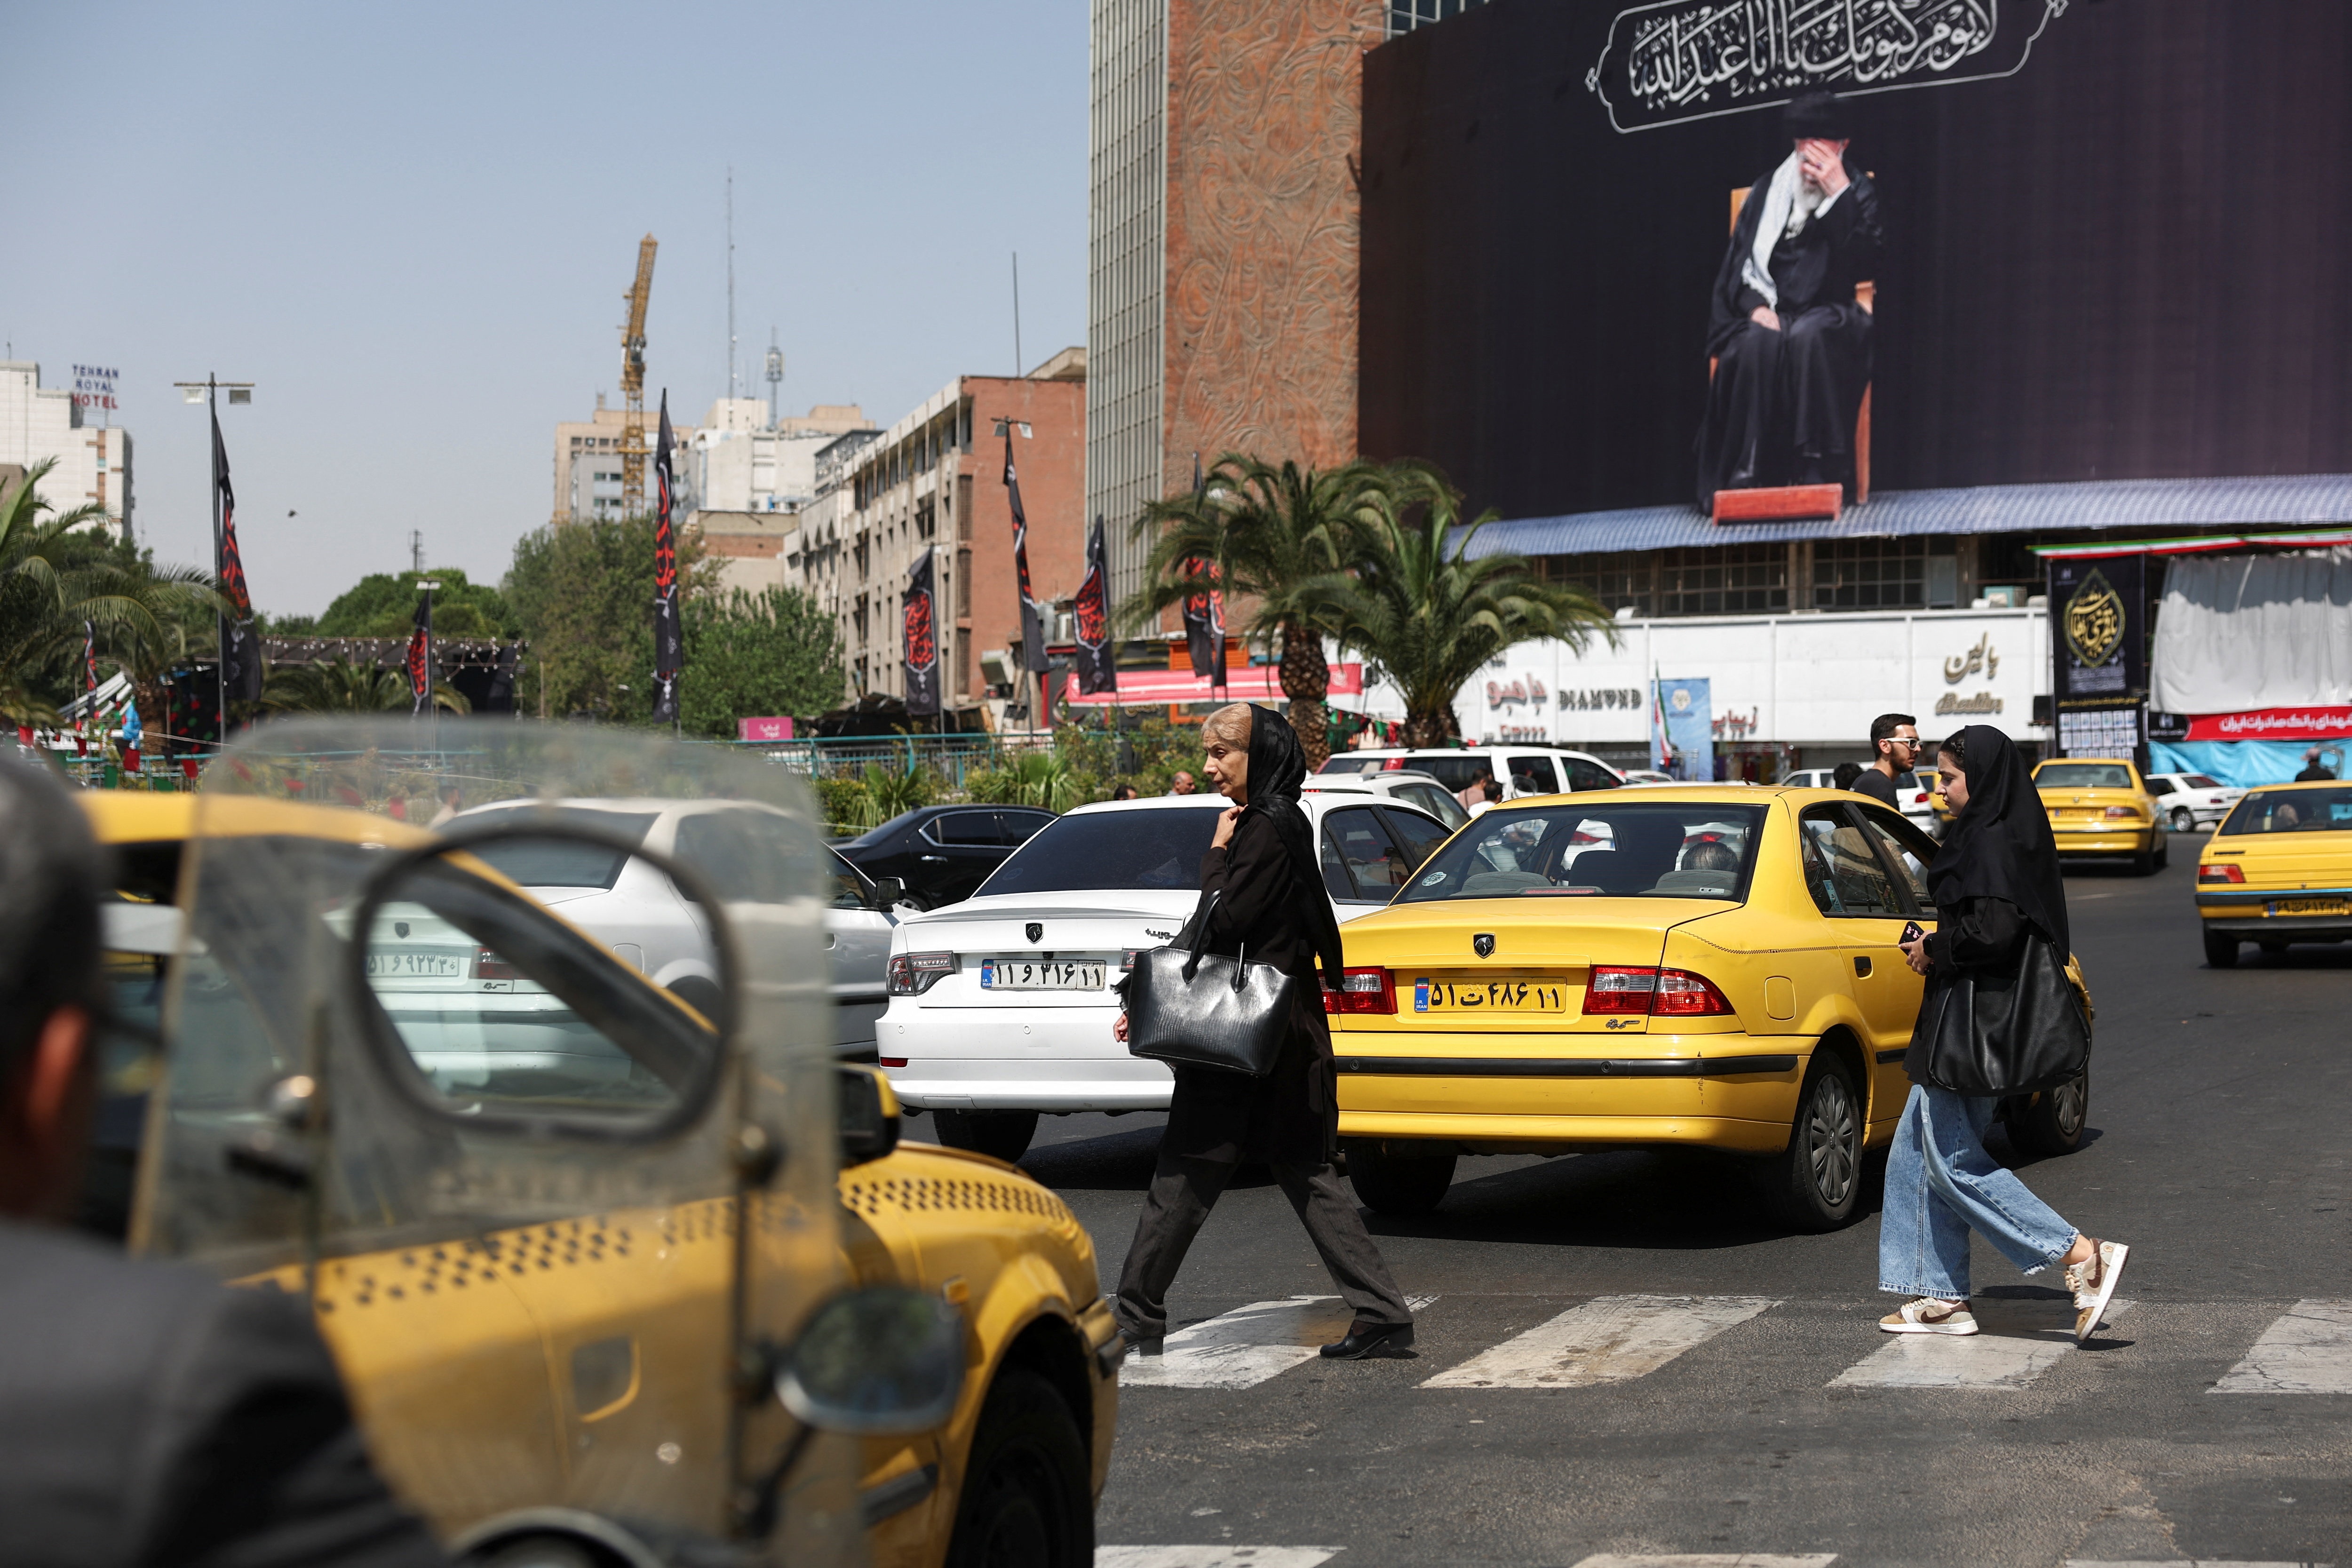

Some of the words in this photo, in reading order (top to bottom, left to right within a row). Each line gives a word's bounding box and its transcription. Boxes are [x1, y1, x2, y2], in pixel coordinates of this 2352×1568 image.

[73, 364, 119, 378] TEHRAN
[76, 379, 114, 392] ROYAL
[72, 393, 119, 409] HOTEL
[1944, 631, 1999, 685] بالین
[1936, 692, 2004, 716] Balin
[1082, 968, 1100, 986] ۱۱
[1537, 987, 1559, 1008] ۱۱
